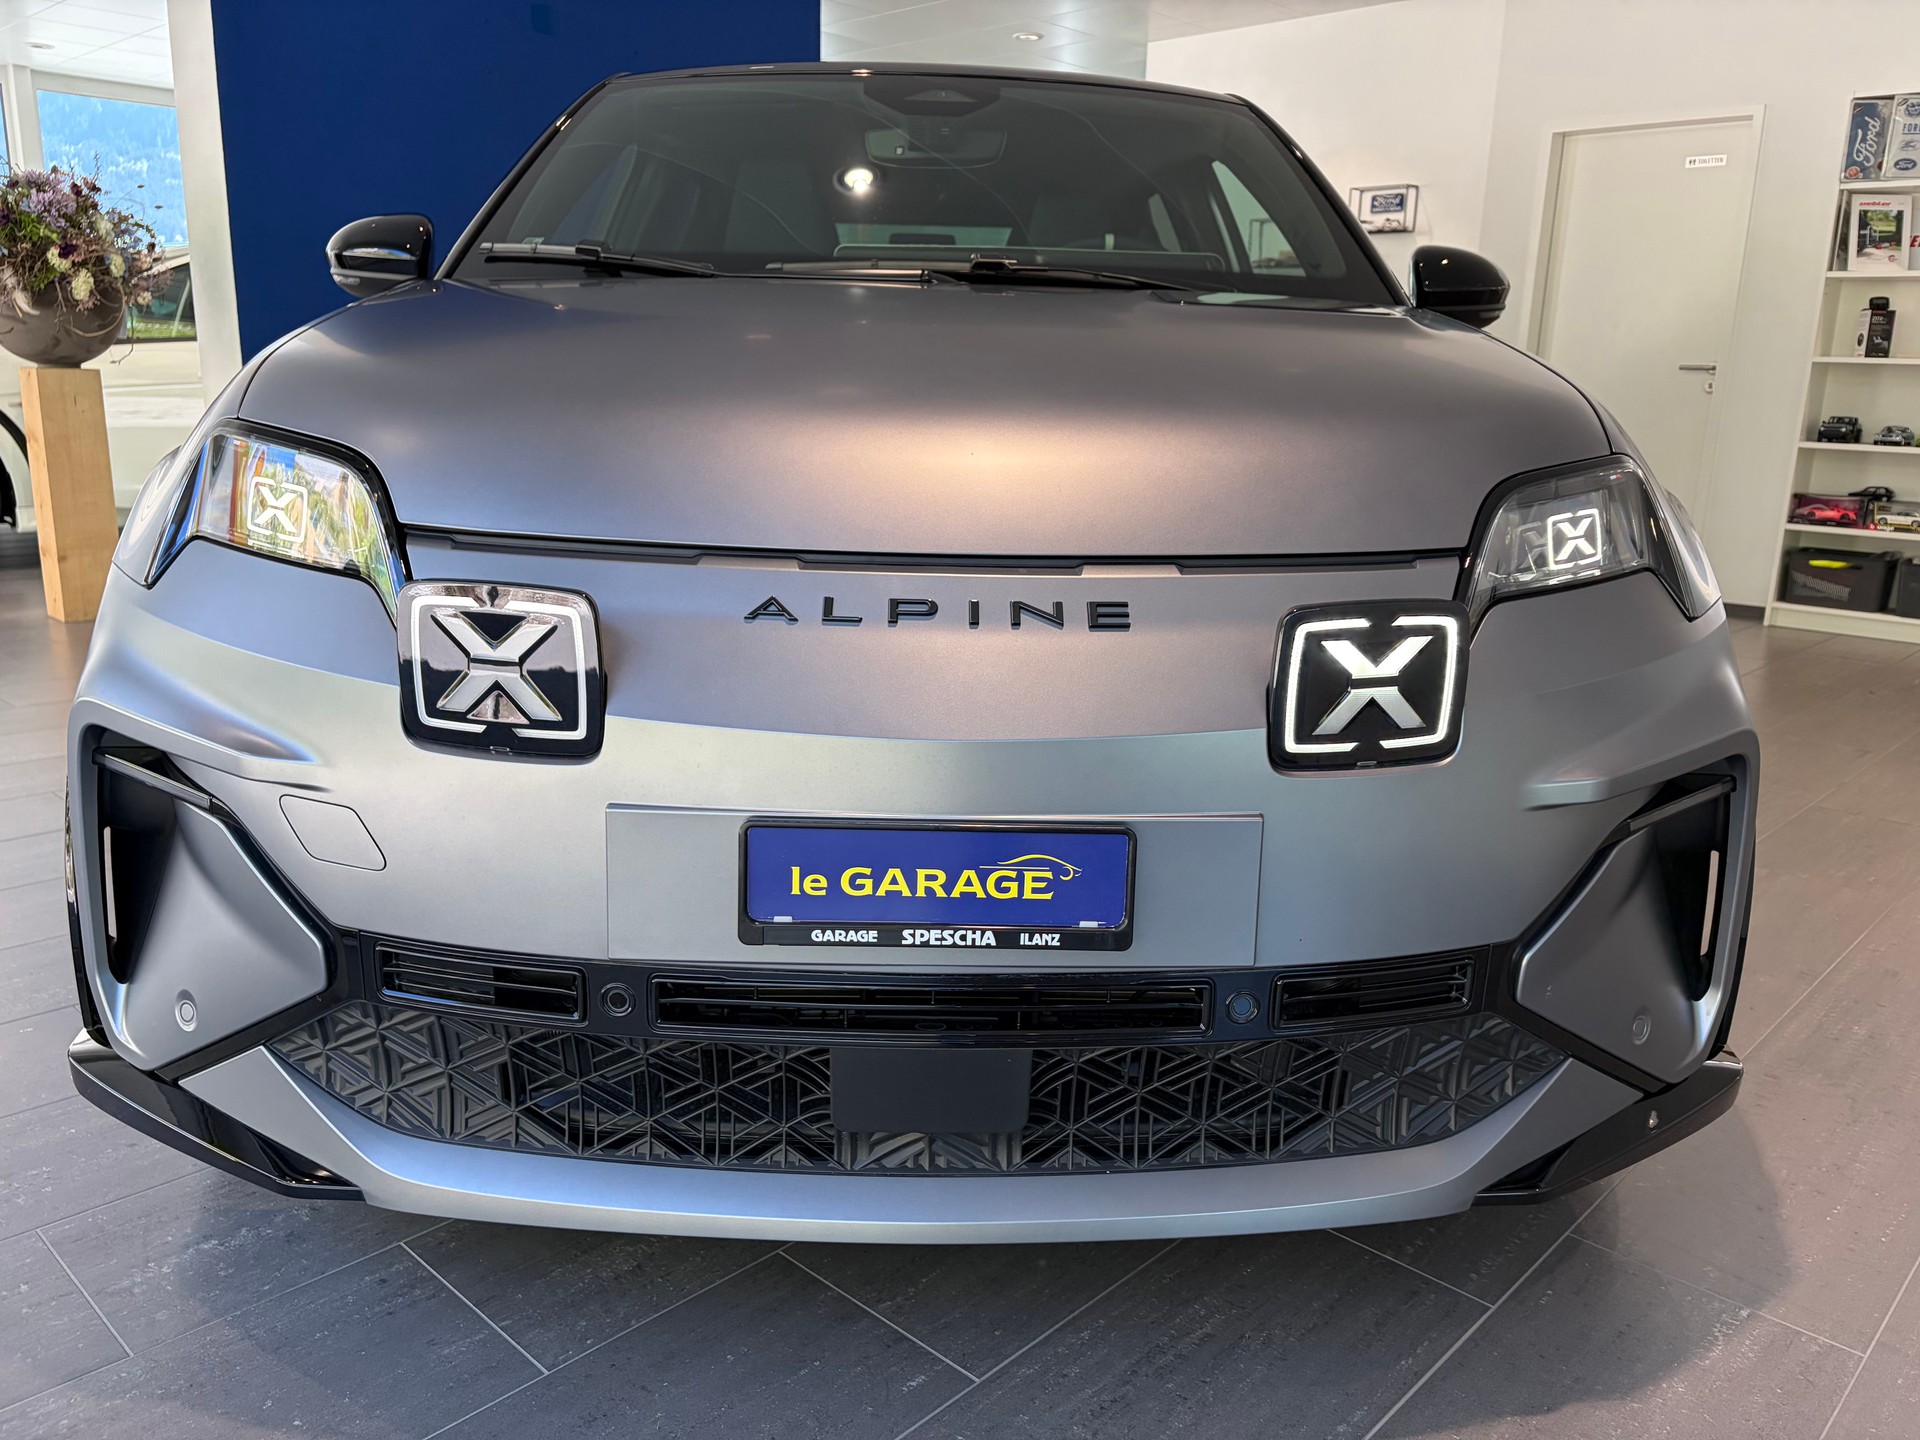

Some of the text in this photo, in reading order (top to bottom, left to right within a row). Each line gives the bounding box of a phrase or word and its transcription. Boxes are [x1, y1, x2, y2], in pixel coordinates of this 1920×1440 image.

[1853, 116, 1880, 167] Ford
[1902, 123, 1920, 133] FOR
[744, 595, 1131, 632] ALPINE
[790, 866, 1054, 900] le GARAGE
[811, 929, 1060, 947] GARAGE SPESCHA ILANZ
